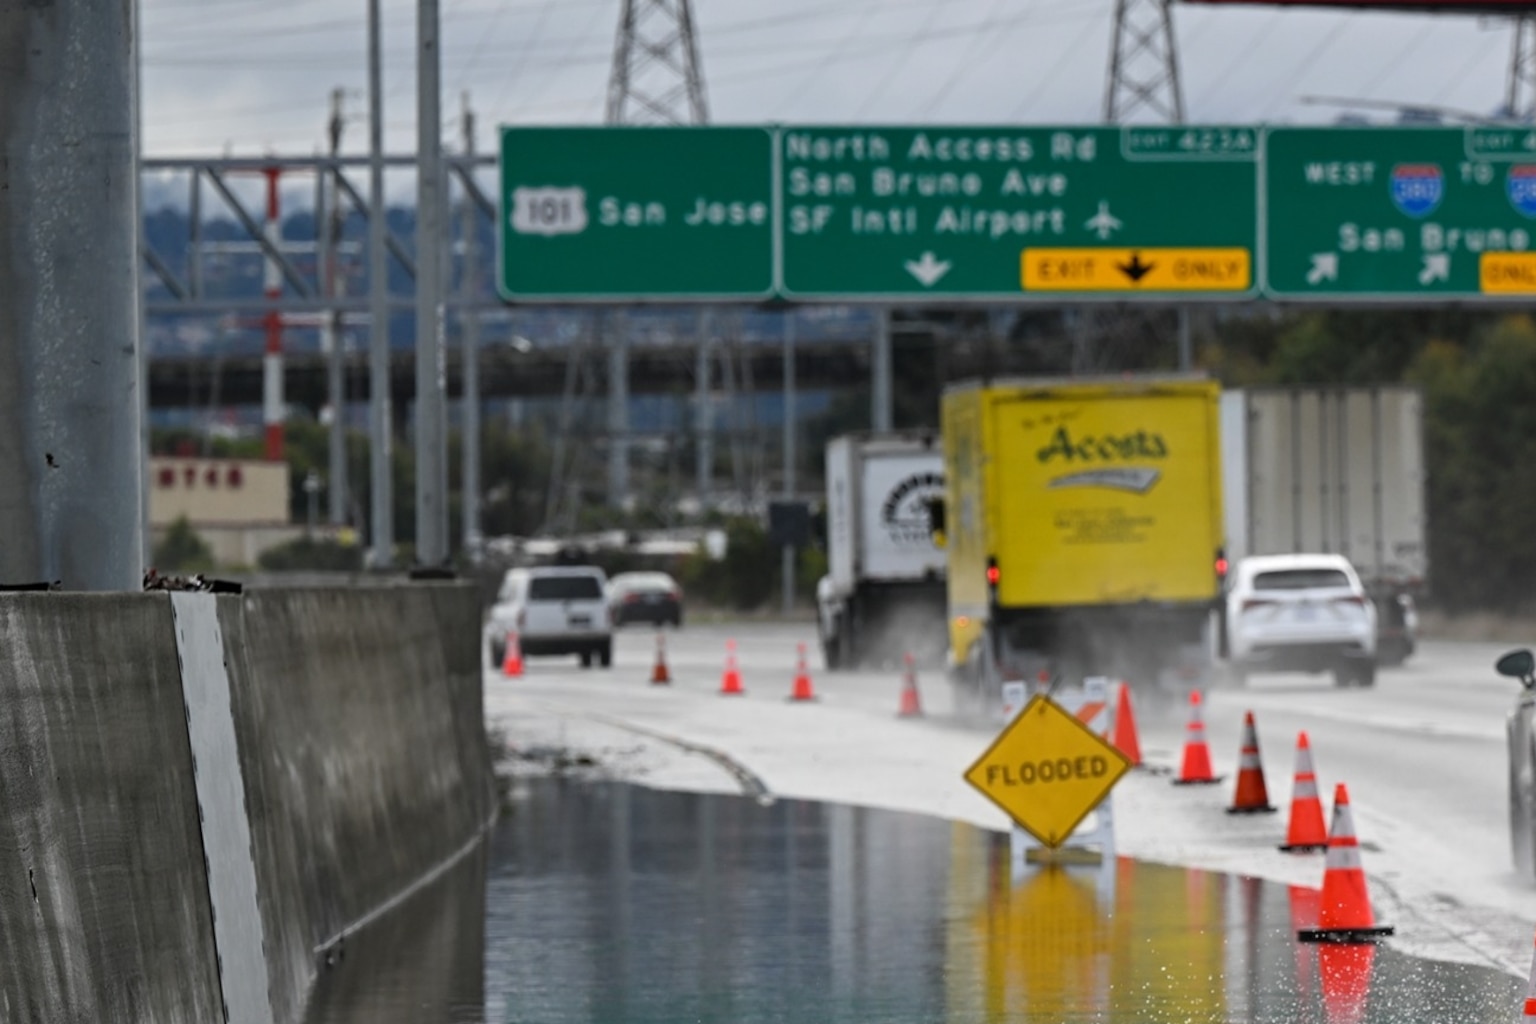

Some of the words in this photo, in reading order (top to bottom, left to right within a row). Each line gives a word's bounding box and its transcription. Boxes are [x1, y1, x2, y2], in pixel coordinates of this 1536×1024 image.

[787, 132, 889, 161] North
[908, 132, 1034, 161] Access
[1051, 132, 1097, 161] Rd
[789, 167, 855, 196] San
[872, 167, 982, 196] Bruno
[1001, 168, 1067, 196] Ave
[1305, 162, 1375, 184] WEST
[1460, 162, 1494, 185] TO
[528, 197, 572, 226] 101
[600, 197, 666, 226] San
[685, 197, 767, 226] Jose
[789, 205, 834, 234] SF
[852, 206, 917, 234] Intl
[935, 206, 1065, 239] Airport
[1338, 222, 1405, 251] San
[1420, 222, 1529, 251] Bruno
[1036, 258, 1095, 280] EXIT
[1172, 258, 1240, 281] ONLY
[1036, 425, 1170, 463] Acosta
[985, 754, 1109, 787] FLOODED
